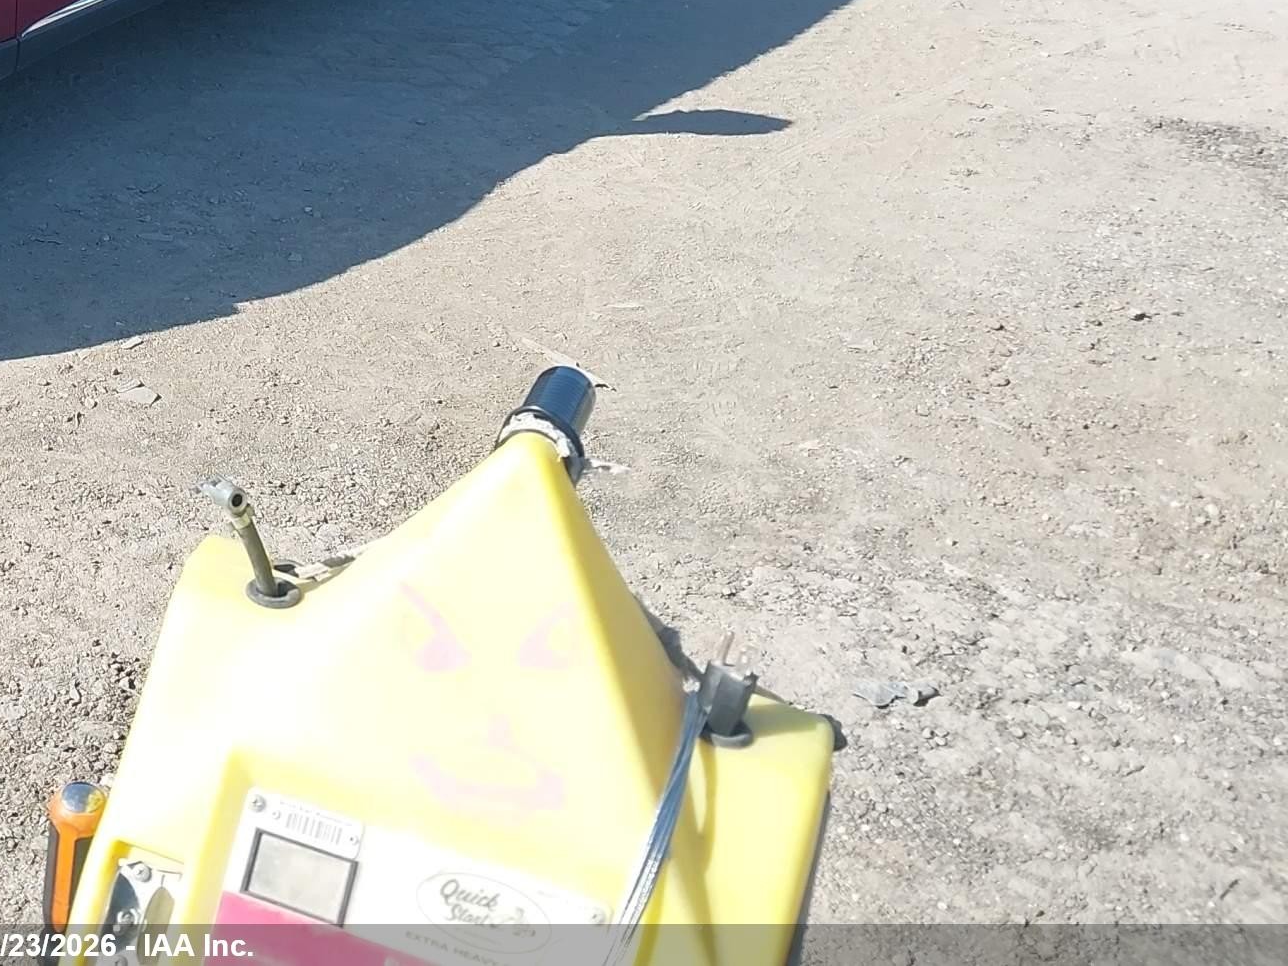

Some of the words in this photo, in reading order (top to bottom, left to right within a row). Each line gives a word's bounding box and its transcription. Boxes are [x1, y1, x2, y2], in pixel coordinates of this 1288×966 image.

[439, 878, 501, 912] Quick
[447, 903, 491, 927] Start
[405, 930, 449, 952] EXTRA
